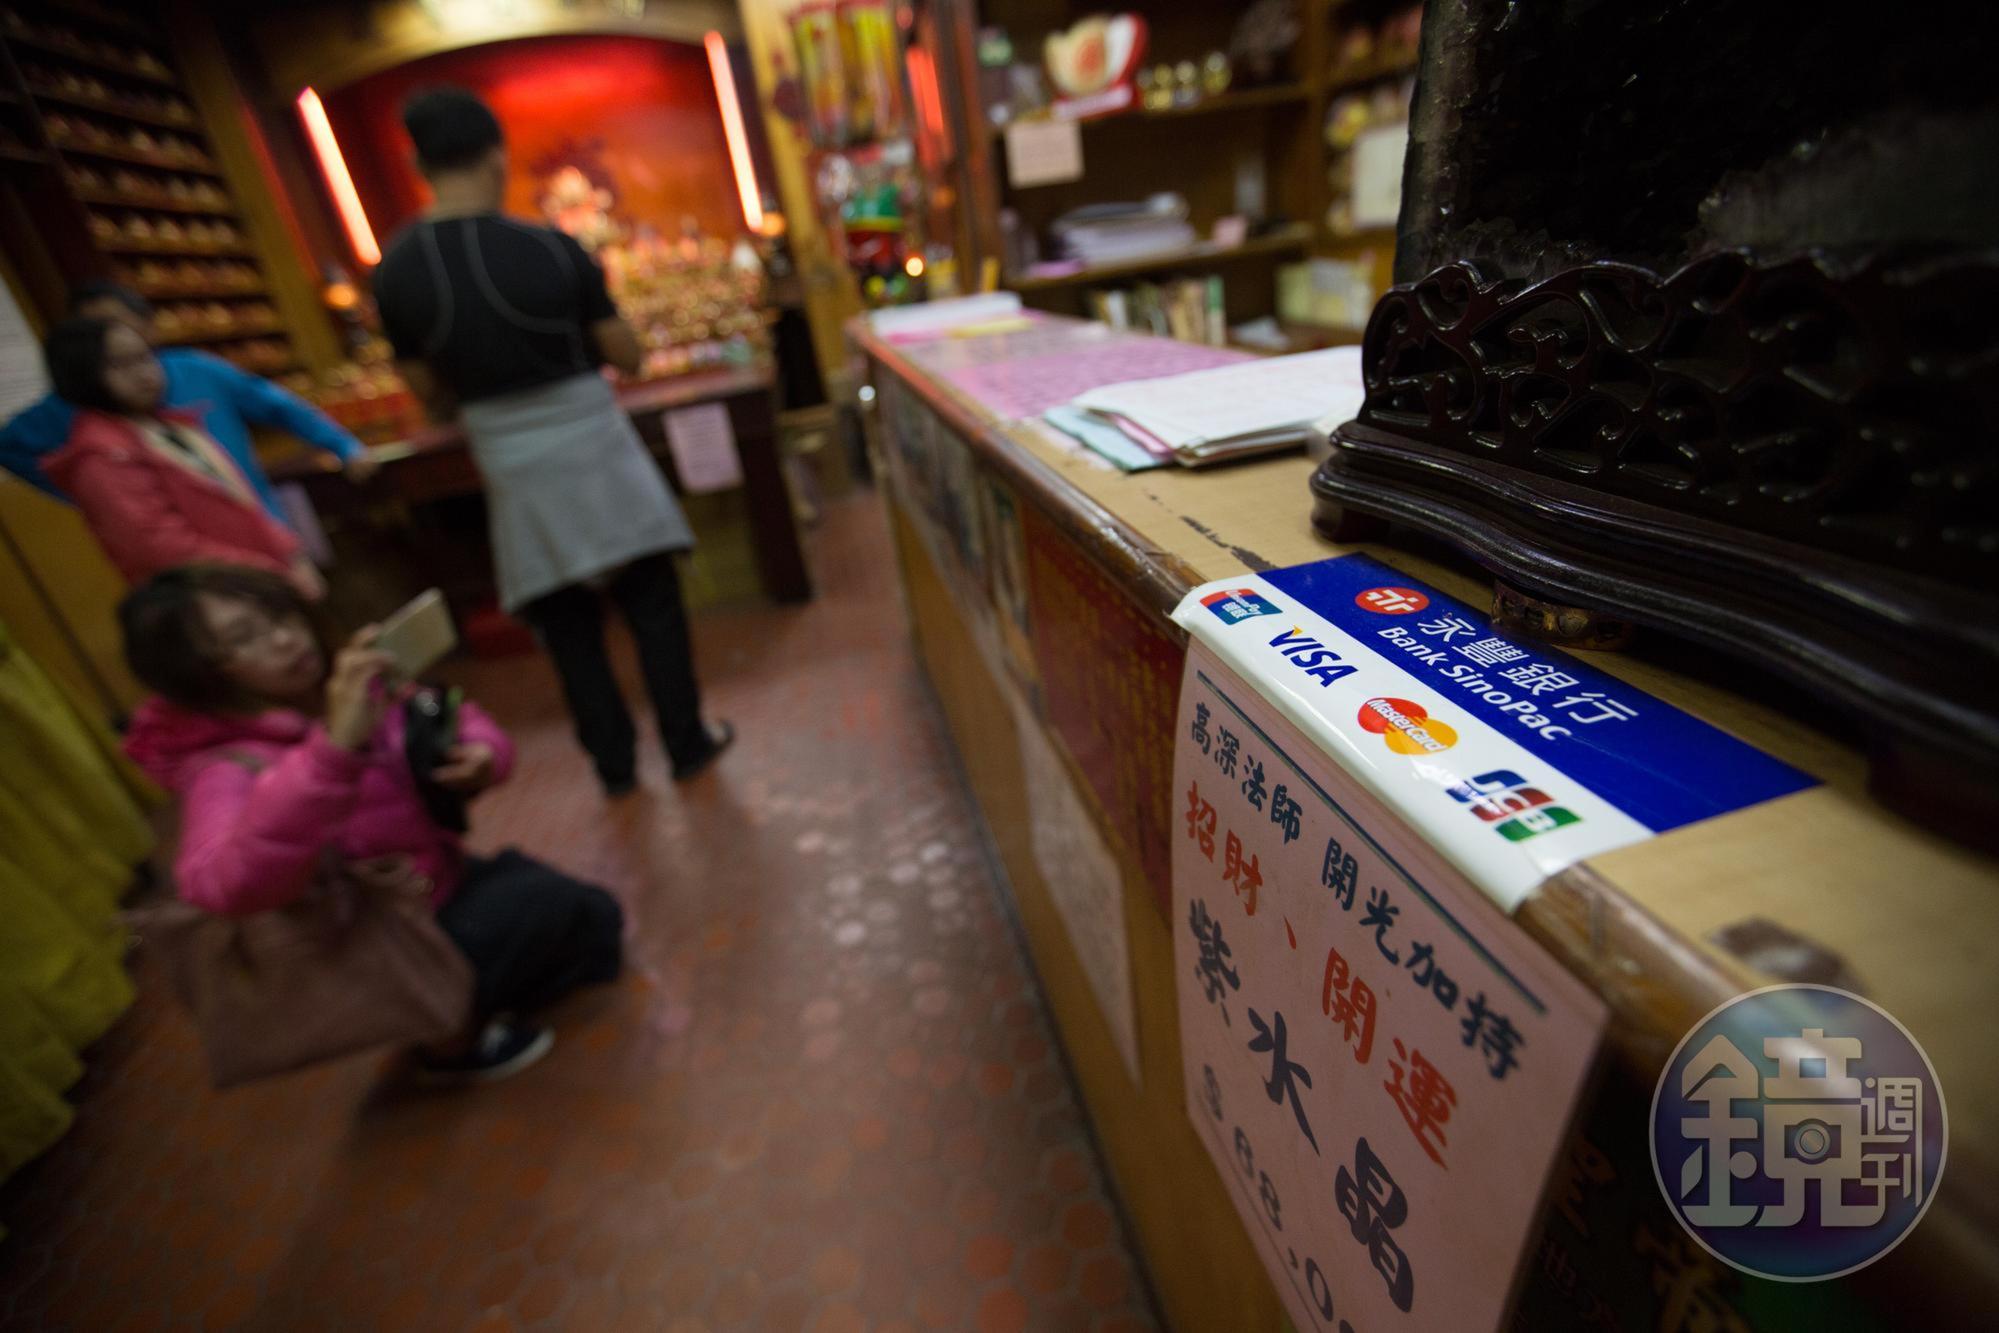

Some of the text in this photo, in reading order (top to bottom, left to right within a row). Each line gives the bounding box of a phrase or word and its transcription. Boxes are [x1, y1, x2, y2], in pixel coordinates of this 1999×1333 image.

[1269, 625, 1359, 688] VISA
[1377, 626, 1573, 741] Bank SinoPac
[1417, 617, 1639, 724] 永豐銀行
[1366, 698, 1448, 752] MasterCard
[1445, 768, 1583, 843] JCB
[1191, 701, 1527, 1081] 高深法師 開光加持
